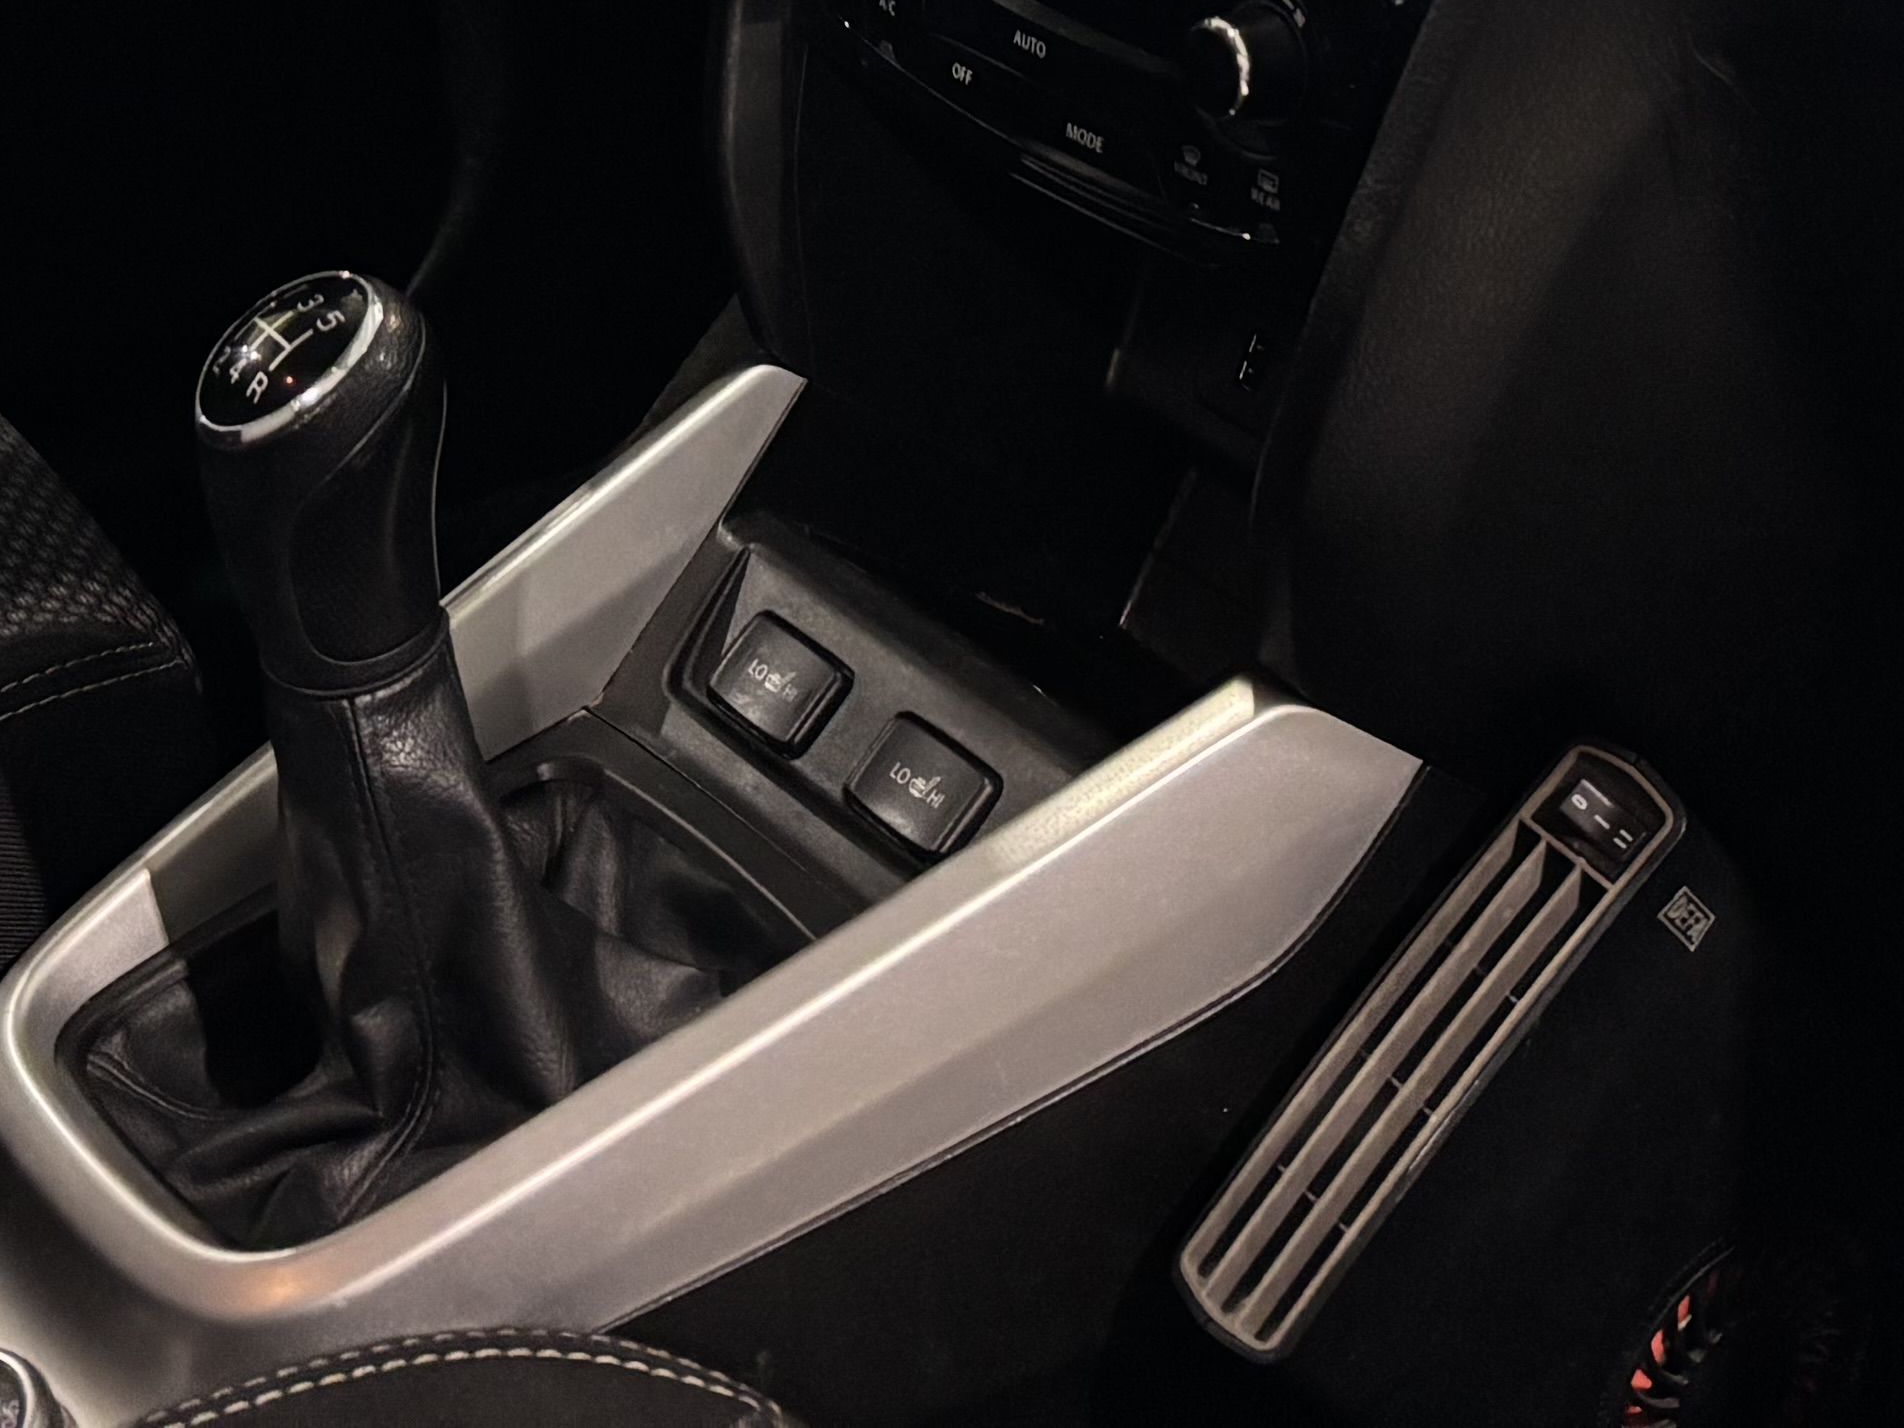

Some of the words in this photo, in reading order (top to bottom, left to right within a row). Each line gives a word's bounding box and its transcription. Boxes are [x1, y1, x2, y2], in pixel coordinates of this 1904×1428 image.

[1013, 29, 1047, 59] AUTO
[951, 62, 973, 85] OFF
[1065, 122, 1103, 154] MODE
[296, 293, 325, 313] 3
[316, 309, 346, 332] 5
[228, 358, 250, 385] 4
[245, 371, 270, 405] R
[747, 658, 769, 681] LO
[889, 761, 912, 785] LO
[925, 790, 945, 809] HI
